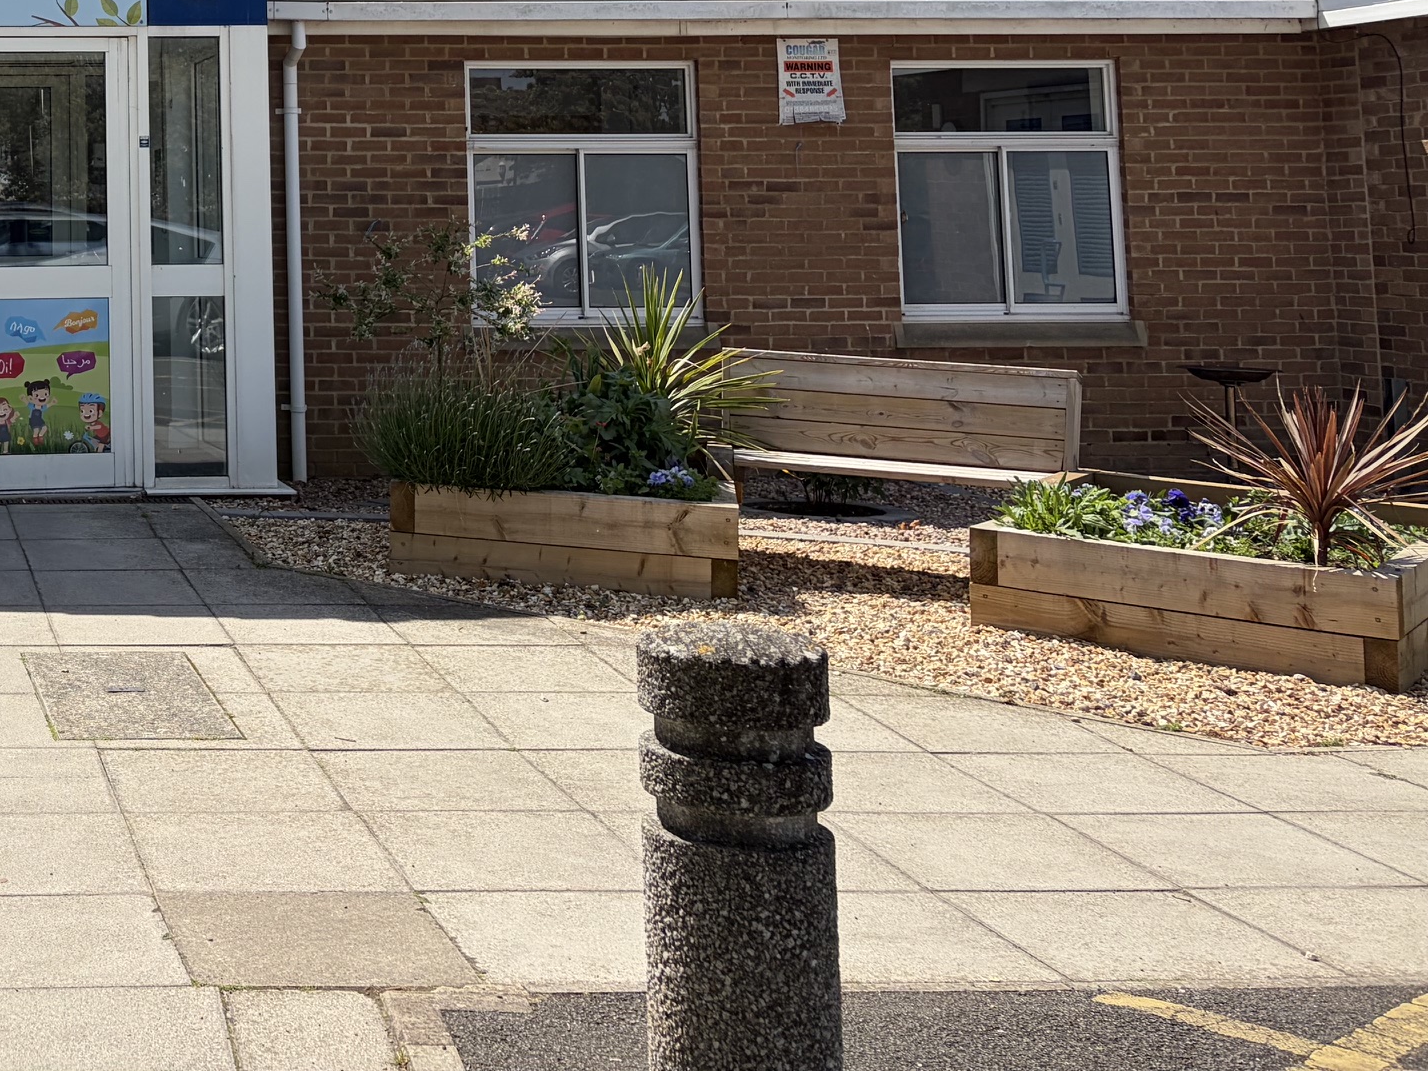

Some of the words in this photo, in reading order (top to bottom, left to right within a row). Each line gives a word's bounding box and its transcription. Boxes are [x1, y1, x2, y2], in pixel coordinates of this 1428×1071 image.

[785, 44, 825, 55] COUGAR
[785, 62, 831, 71] WARNING
[64, 315, 95, 328] Bonjour
